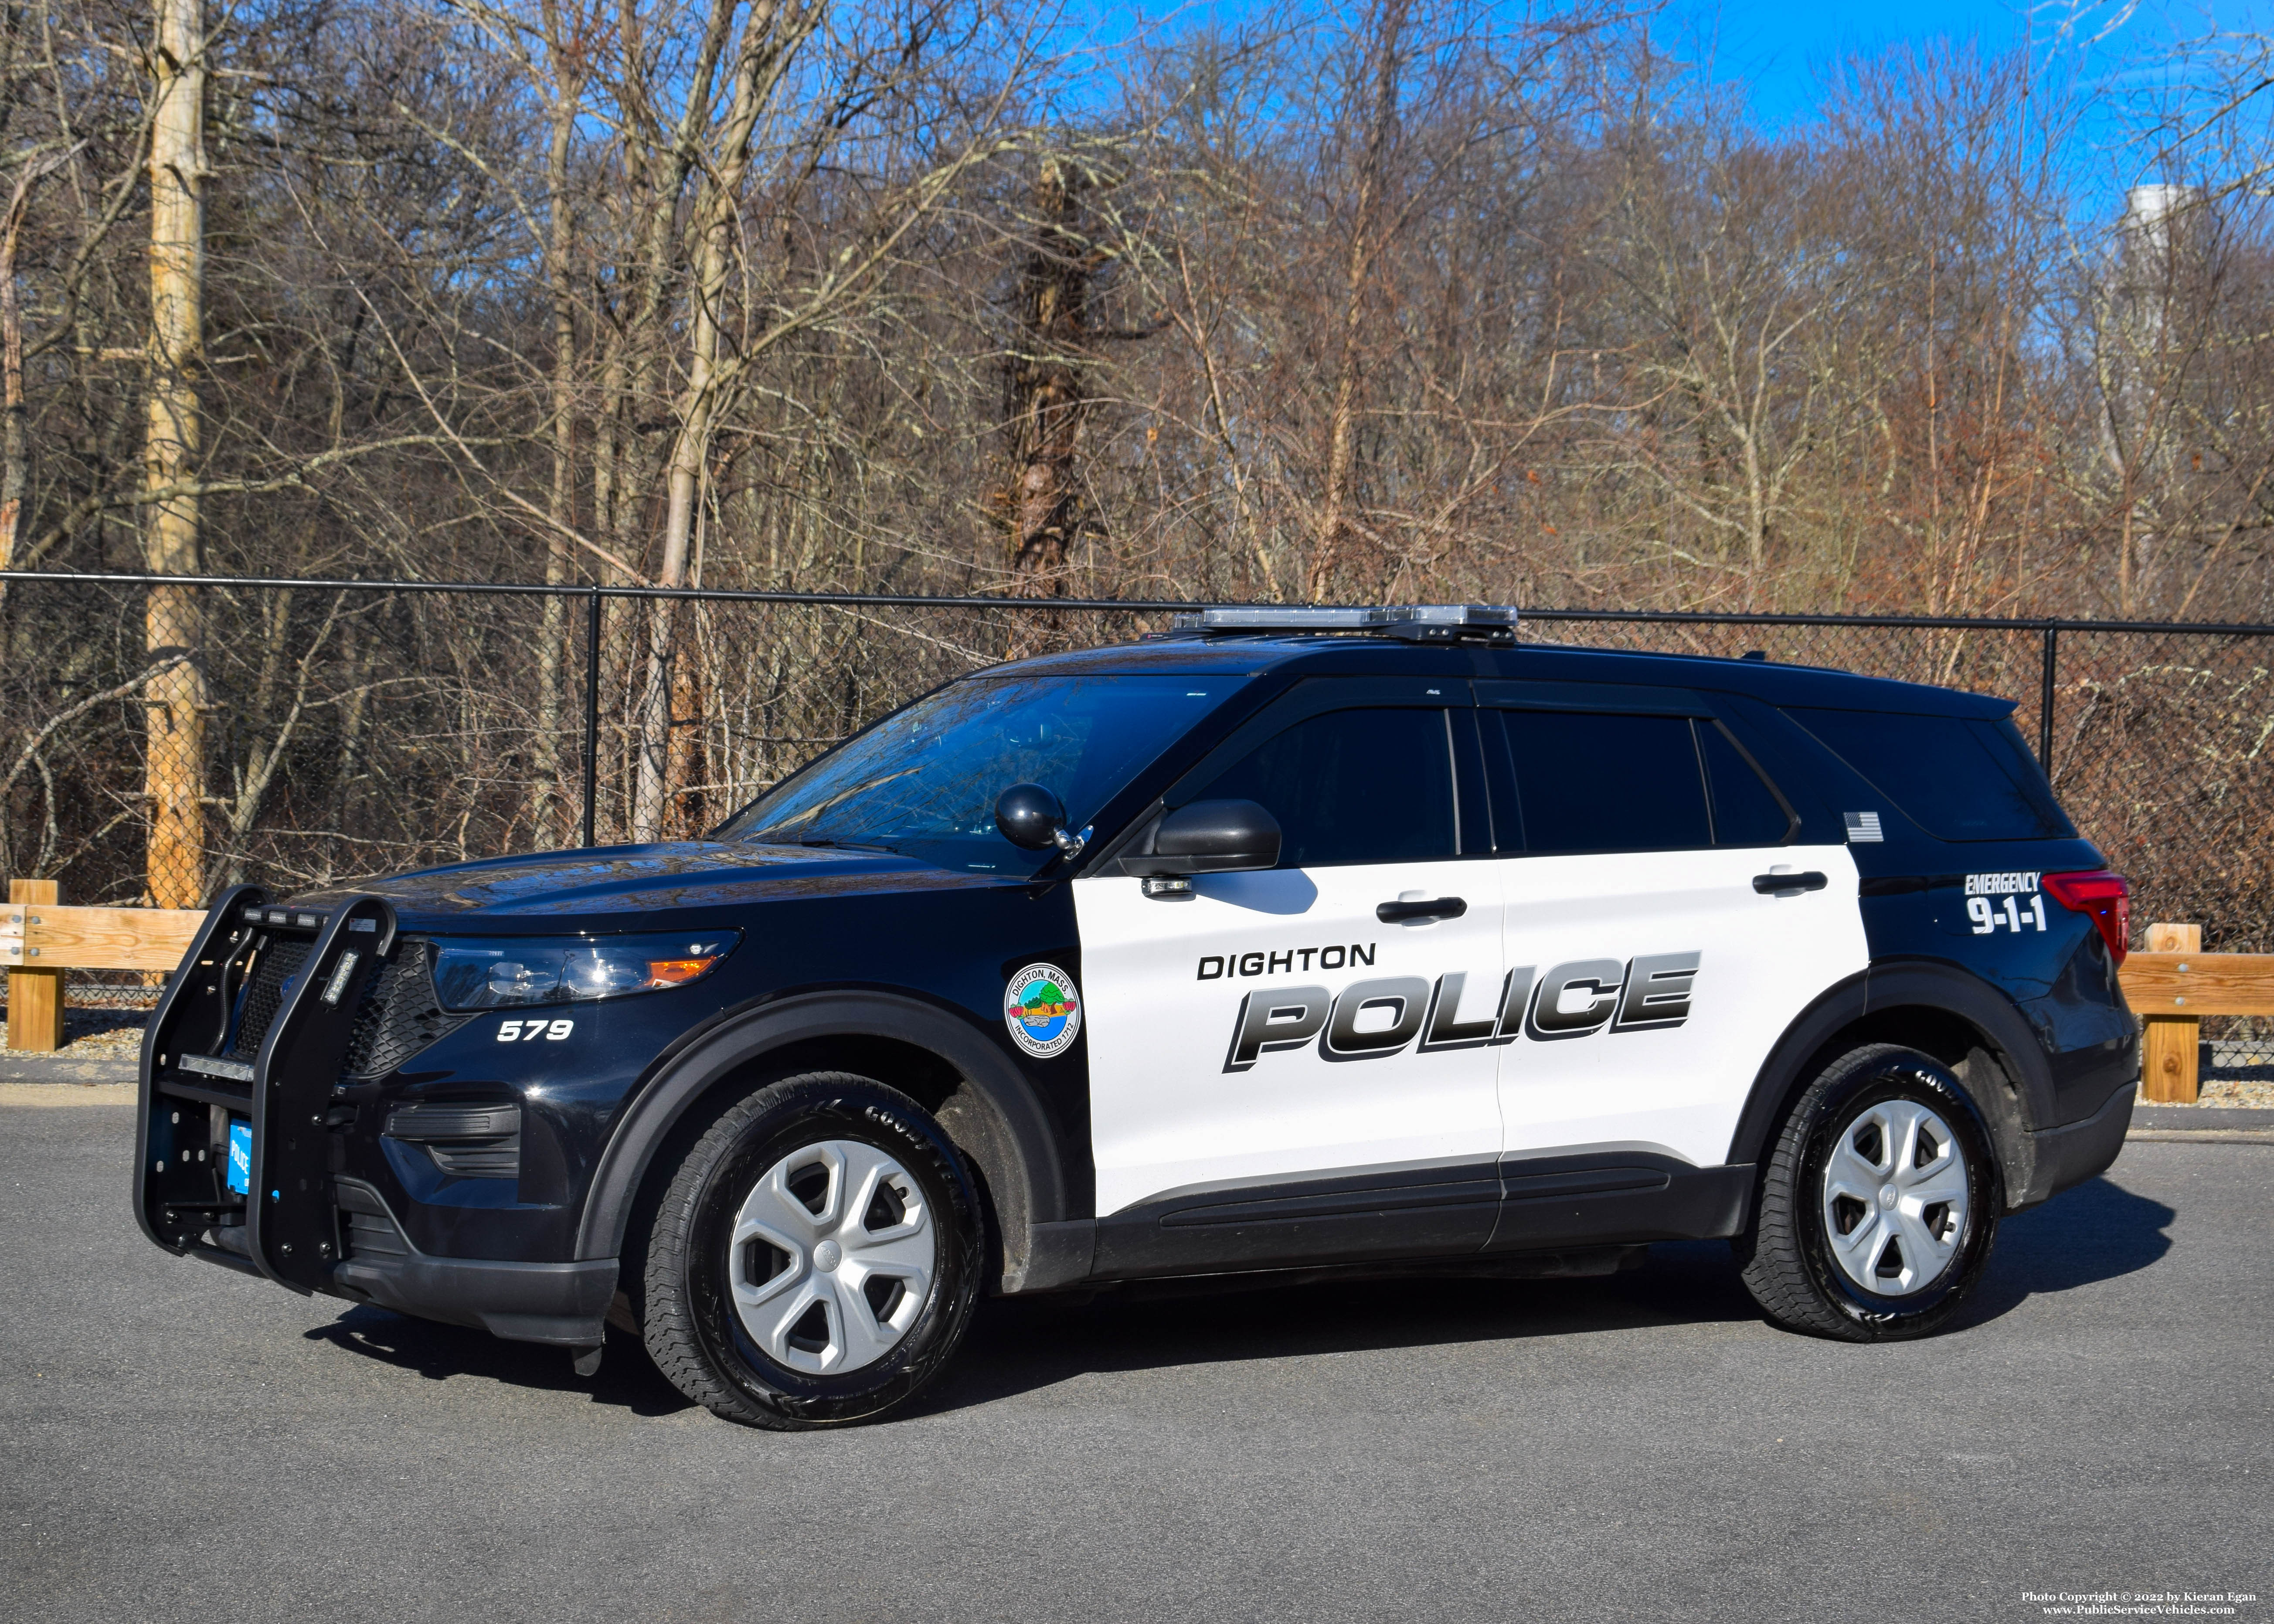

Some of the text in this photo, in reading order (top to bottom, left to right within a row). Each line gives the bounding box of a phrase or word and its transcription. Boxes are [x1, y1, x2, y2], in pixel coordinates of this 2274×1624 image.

[1965, 872, 2041, 895] EMERGENCY
[1967, 894, 2047, 934] 9-1-1
[1196, 942, 1376, 981] DIGHTON
[1012, 969, 1068, 997] DIGHTON, MASS.
[1221, 949, 1703, 1074] POLICE
[497, 1019, 574, 1042] 579
[1015, 1023, 1074, 1050] INCORPORATED 1712
[231, 1140, 249, 1175] POLICE
